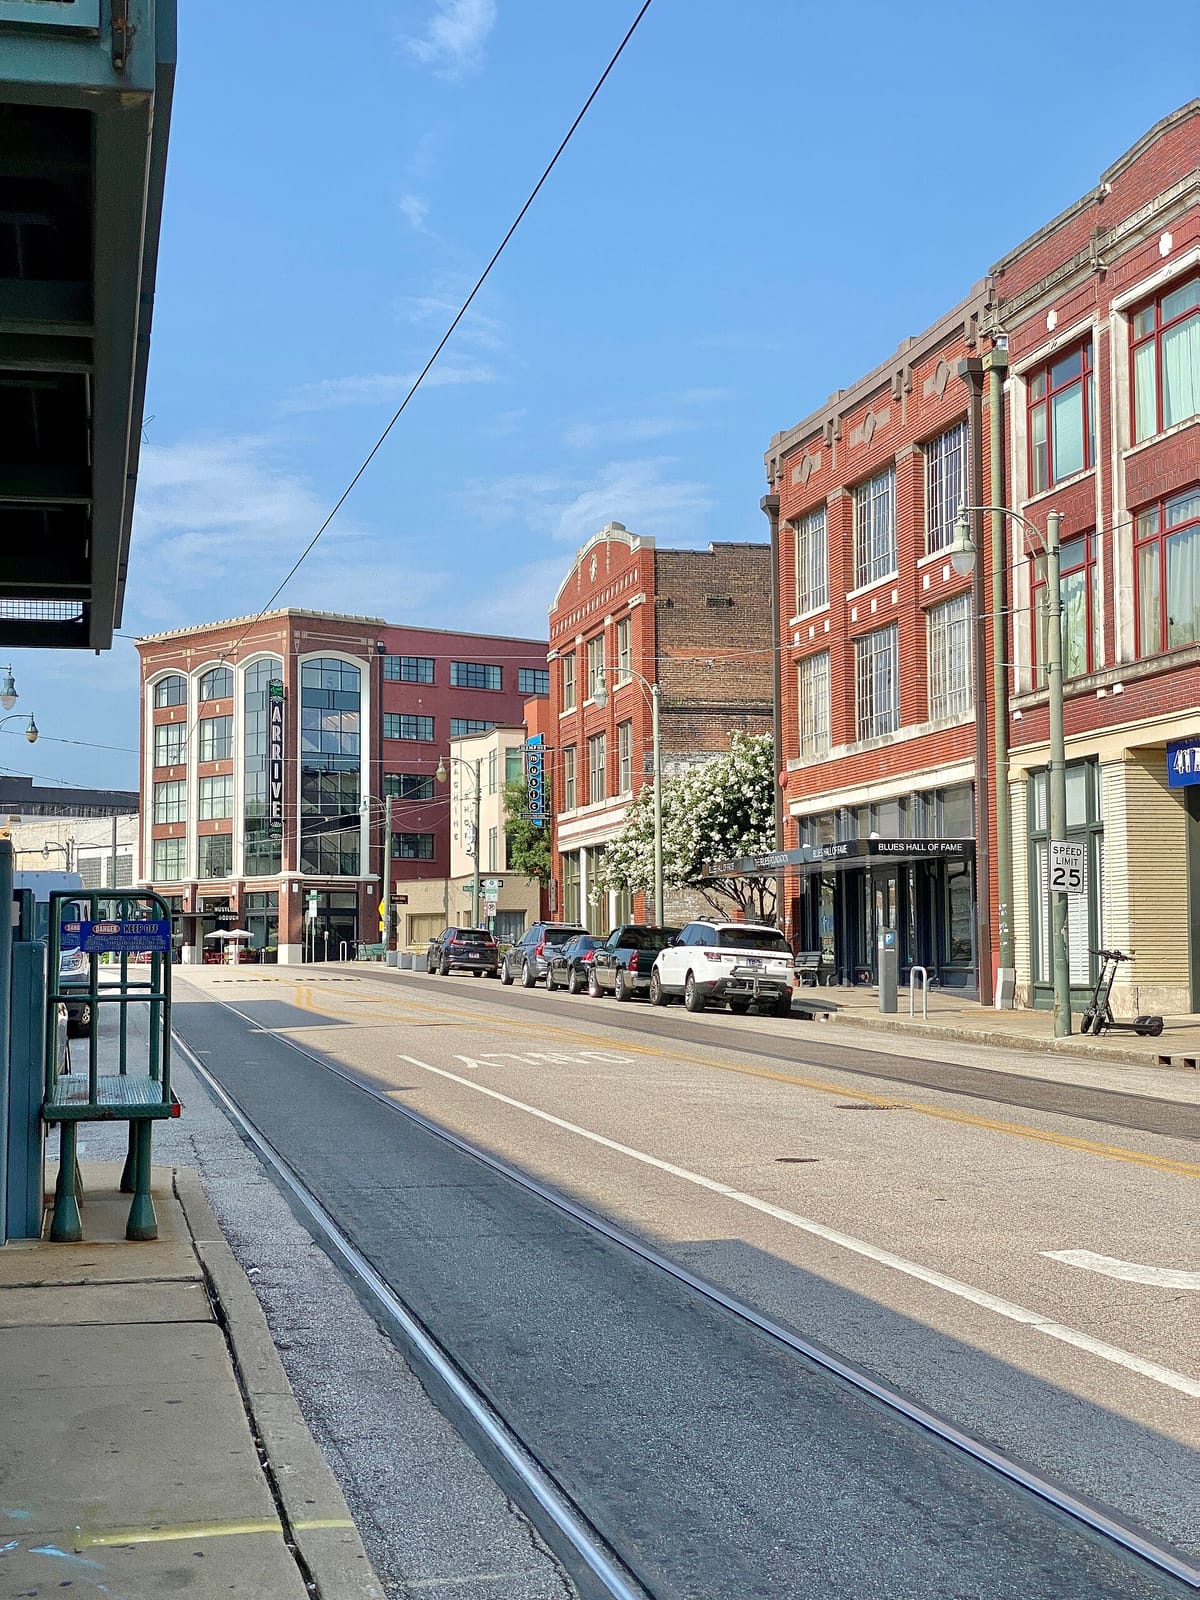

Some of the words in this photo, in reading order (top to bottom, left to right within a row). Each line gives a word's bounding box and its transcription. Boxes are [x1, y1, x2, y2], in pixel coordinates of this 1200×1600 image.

[272, 705, 281, 817] ARRIVE
[878, 843, 904, 851] BLUES
[906, 843, 926, 851] HALL
[927, 843, 939, 851] OF
[940, 843, 963, 851] FAME
[1052, 846, 1082, 857] SPEED
[1055, 857, 1078, 866] LIMIT
[1052, 867, 1081, 887] 25
[95, 925, 118, 933] DANGER
[123, 923, 143, 934] KEEP
[143, 923, 159, 934] OFF
